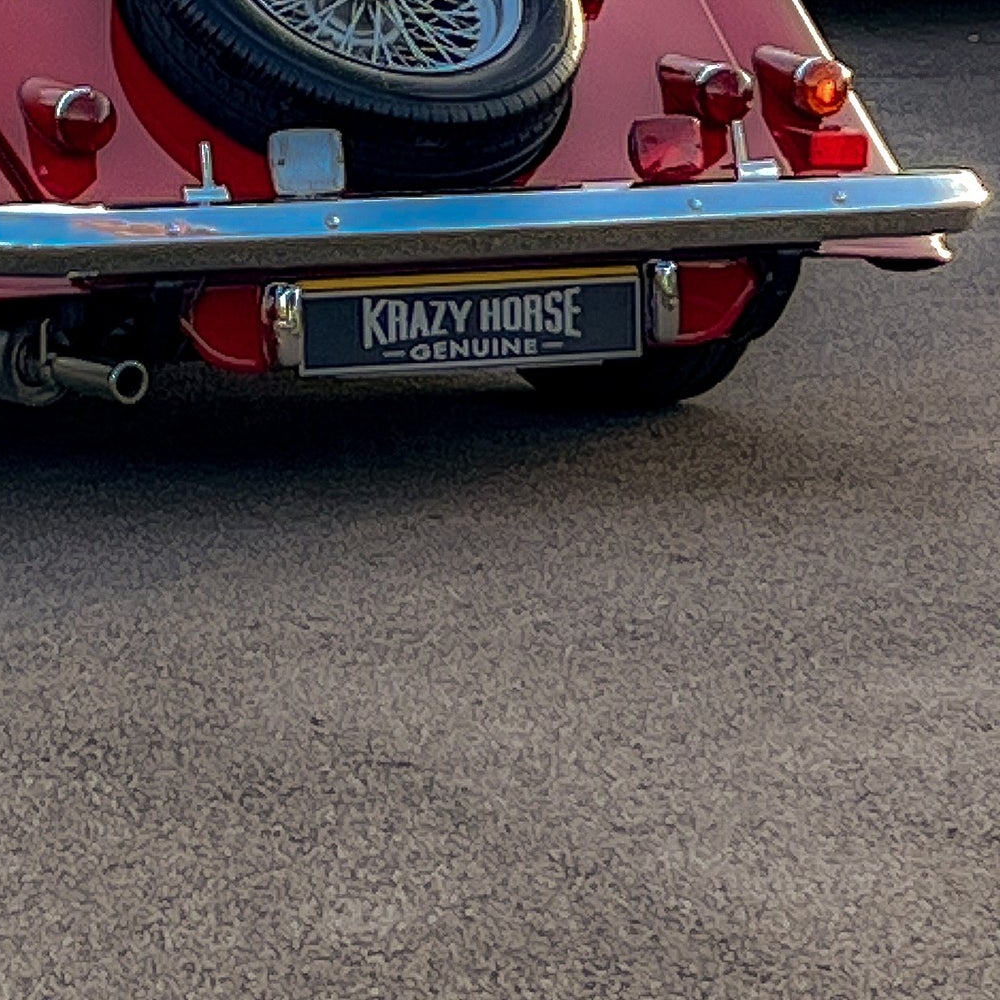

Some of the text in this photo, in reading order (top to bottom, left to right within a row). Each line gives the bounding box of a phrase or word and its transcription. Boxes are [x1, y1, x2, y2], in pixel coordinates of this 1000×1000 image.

[361, 286, 582, 350] KRAZY HORSE
[409, 337, 539, 361] GENUINE
